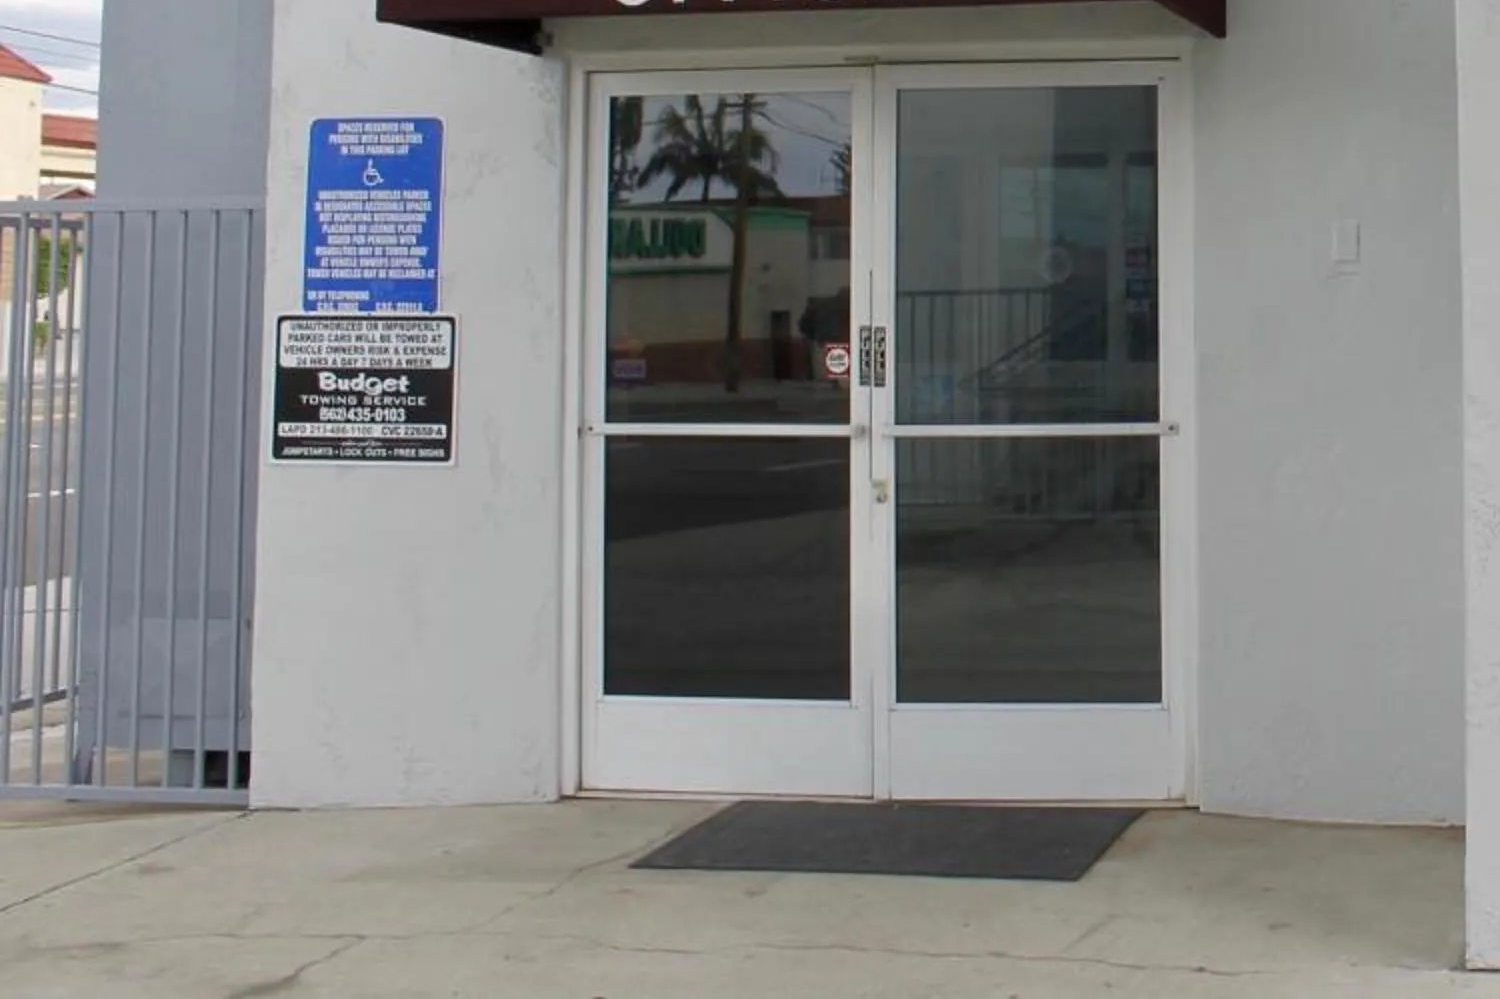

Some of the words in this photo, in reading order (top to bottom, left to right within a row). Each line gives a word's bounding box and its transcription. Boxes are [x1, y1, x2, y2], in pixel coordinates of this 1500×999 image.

[290, 322, 363, 332] UNAUTHORIZED
[366, 322, 379, 332] OR
[288, 333, 325, 343] PARKED
[327, 333, 351, 343] CARS
[355, 333, 376, 343] WILL
[380, 333, 391, 343] BE
[395, 333, 429, 343] TOWED
[431, 333, 443, 343] AT
[284, 345, 322, 356] VEHICLE
[368, 345, 390, 356] RISK
[403, 345, 447, 356] EXPENSE
[309, 356, 329, 367] HRS
[331, 356, 338, 367] A
[340, 356, 358, 367] DAY
[405, 356, 433, 367] WEEK
[318, 371, 410, 396] Budget
[300, 394, 358, 406] TOWING
[363, 395, 427, 407] SERVICE
[381, 426, 402, 436] CVC
[340, 447, 362, 457] LOCK
